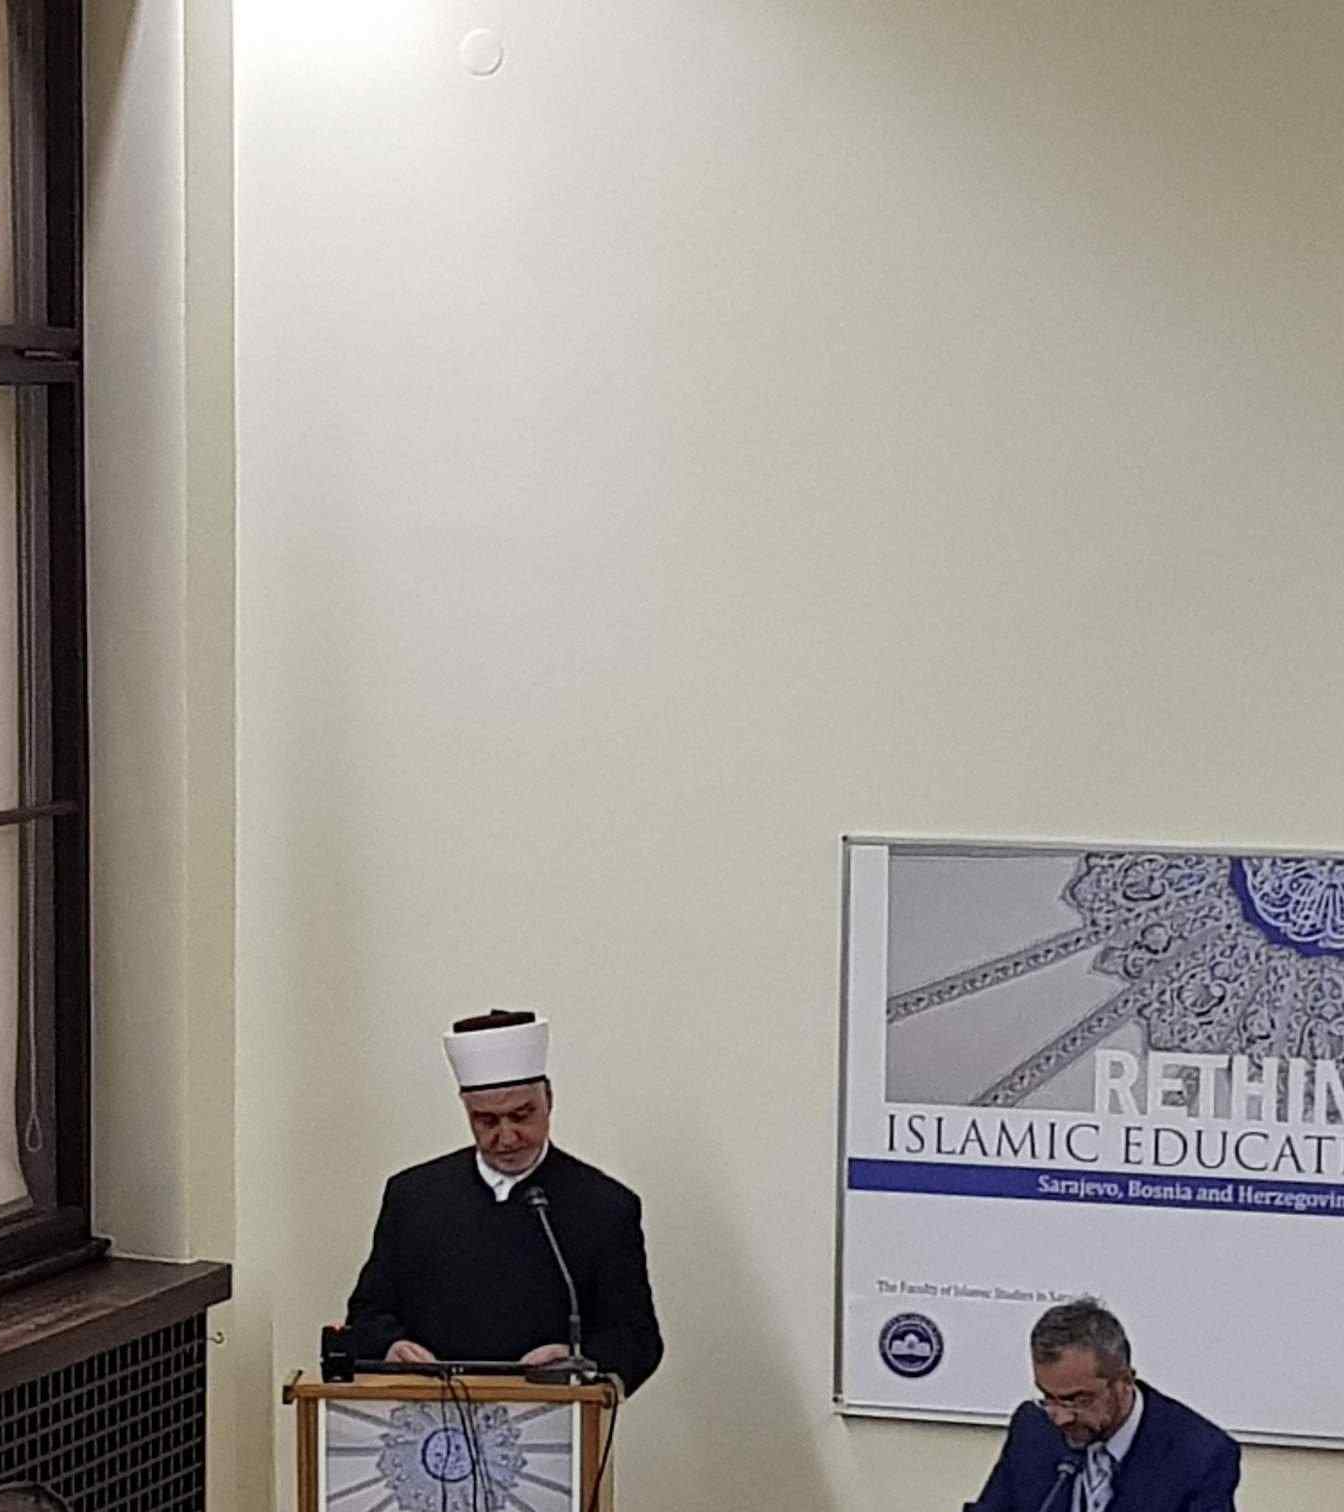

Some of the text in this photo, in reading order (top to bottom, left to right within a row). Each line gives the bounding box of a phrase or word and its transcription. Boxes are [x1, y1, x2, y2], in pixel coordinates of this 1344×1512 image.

[886, 1112, 1101, 1164] ISLAMIC
[1037, 1174, 1124, 1199] Sarajevo,
[1127, 1179, 1192, 1201] Bosnia
[1196, 1182, 1233, 1203] and
